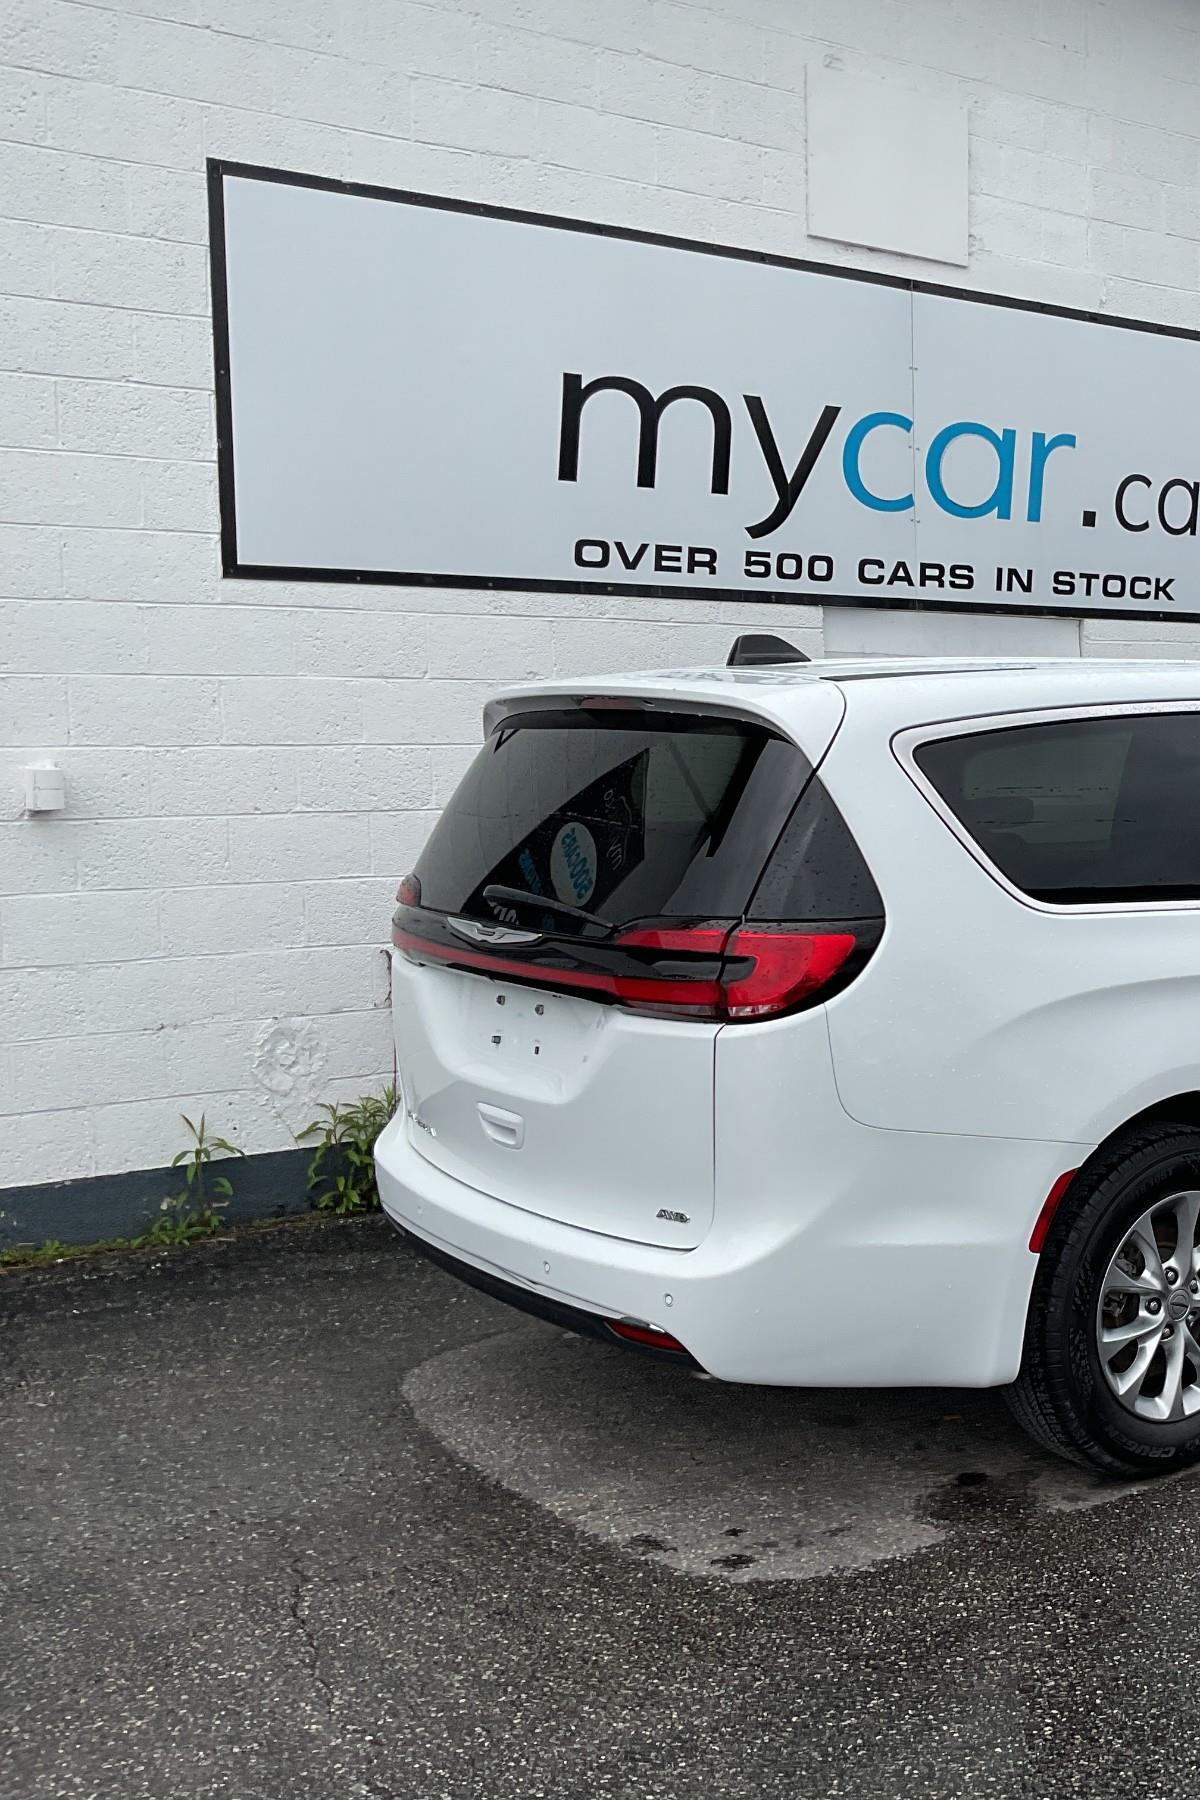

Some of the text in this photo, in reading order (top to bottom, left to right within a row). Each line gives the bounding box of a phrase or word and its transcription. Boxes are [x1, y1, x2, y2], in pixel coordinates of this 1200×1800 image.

[557, 372, 1200, 539] mycar.ca
[573, 538, 1176, 602] OVER 500 CARS IN STOCK
[656, 1208, 690, 1223] AWD
